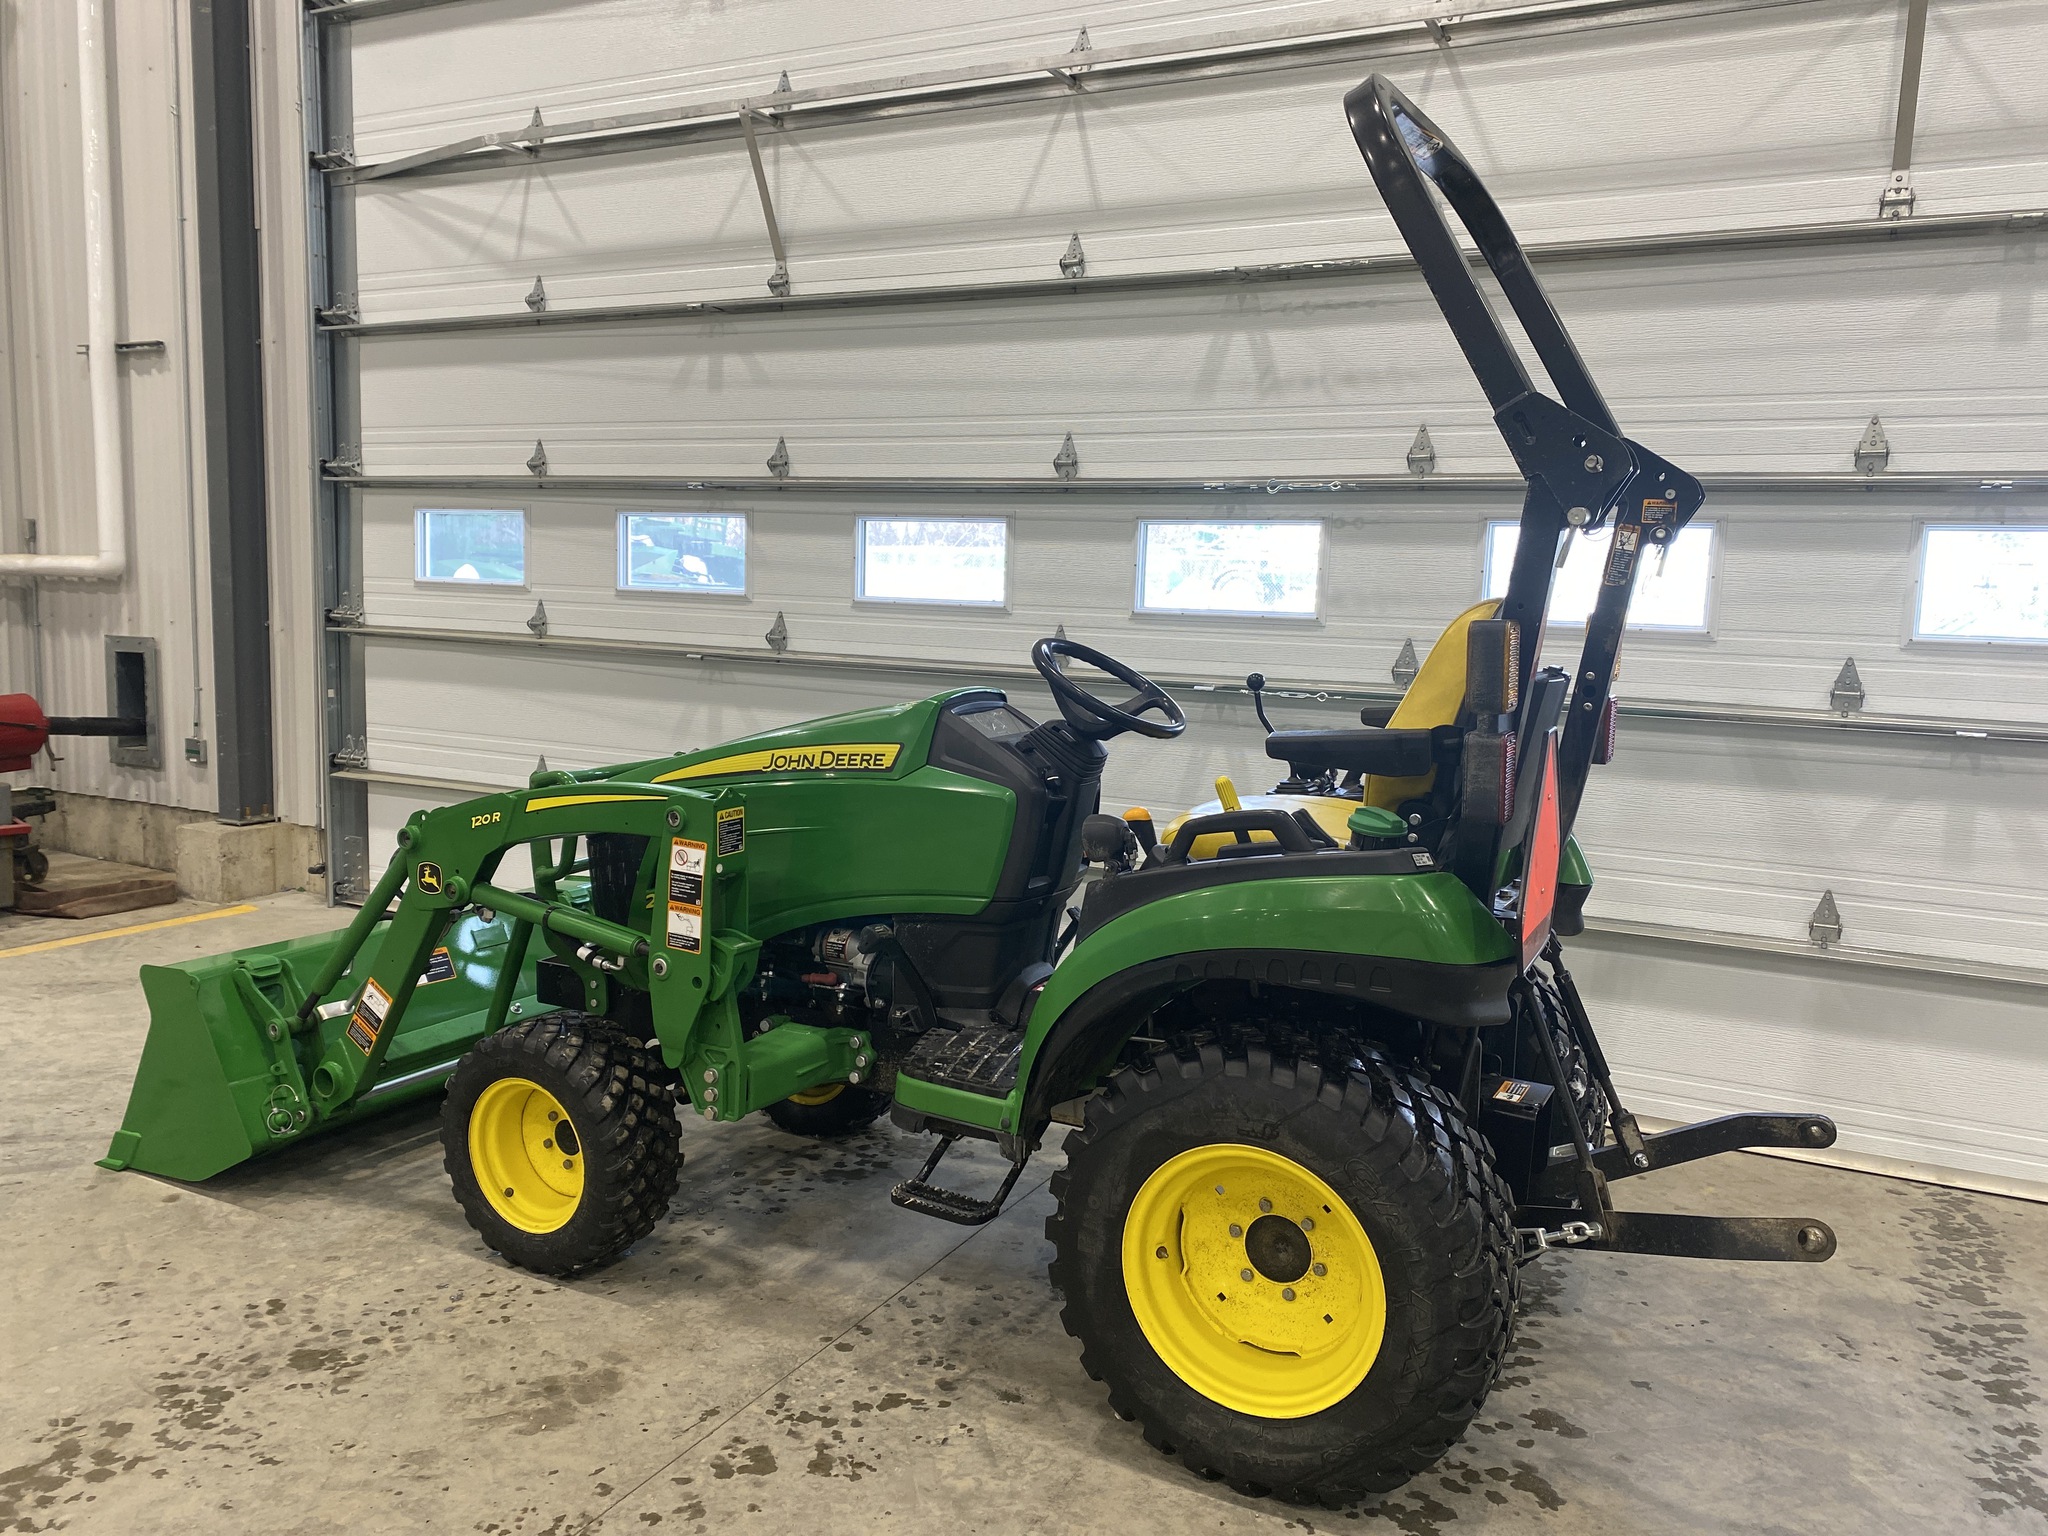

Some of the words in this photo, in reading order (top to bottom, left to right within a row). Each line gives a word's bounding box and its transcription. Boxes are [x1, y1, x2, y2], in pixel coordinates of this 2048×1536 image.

[763, 753, 815, 770] JOHN
[819, 750, 886, 768] DEERE
[724, 809, 743, 819] CAUTION
[471, 814, 491, 829] 120
[492, 811, 501, 823] R
[679, 840, 706, 850] WARNING
[674, 905, 701, 916] WARNING
